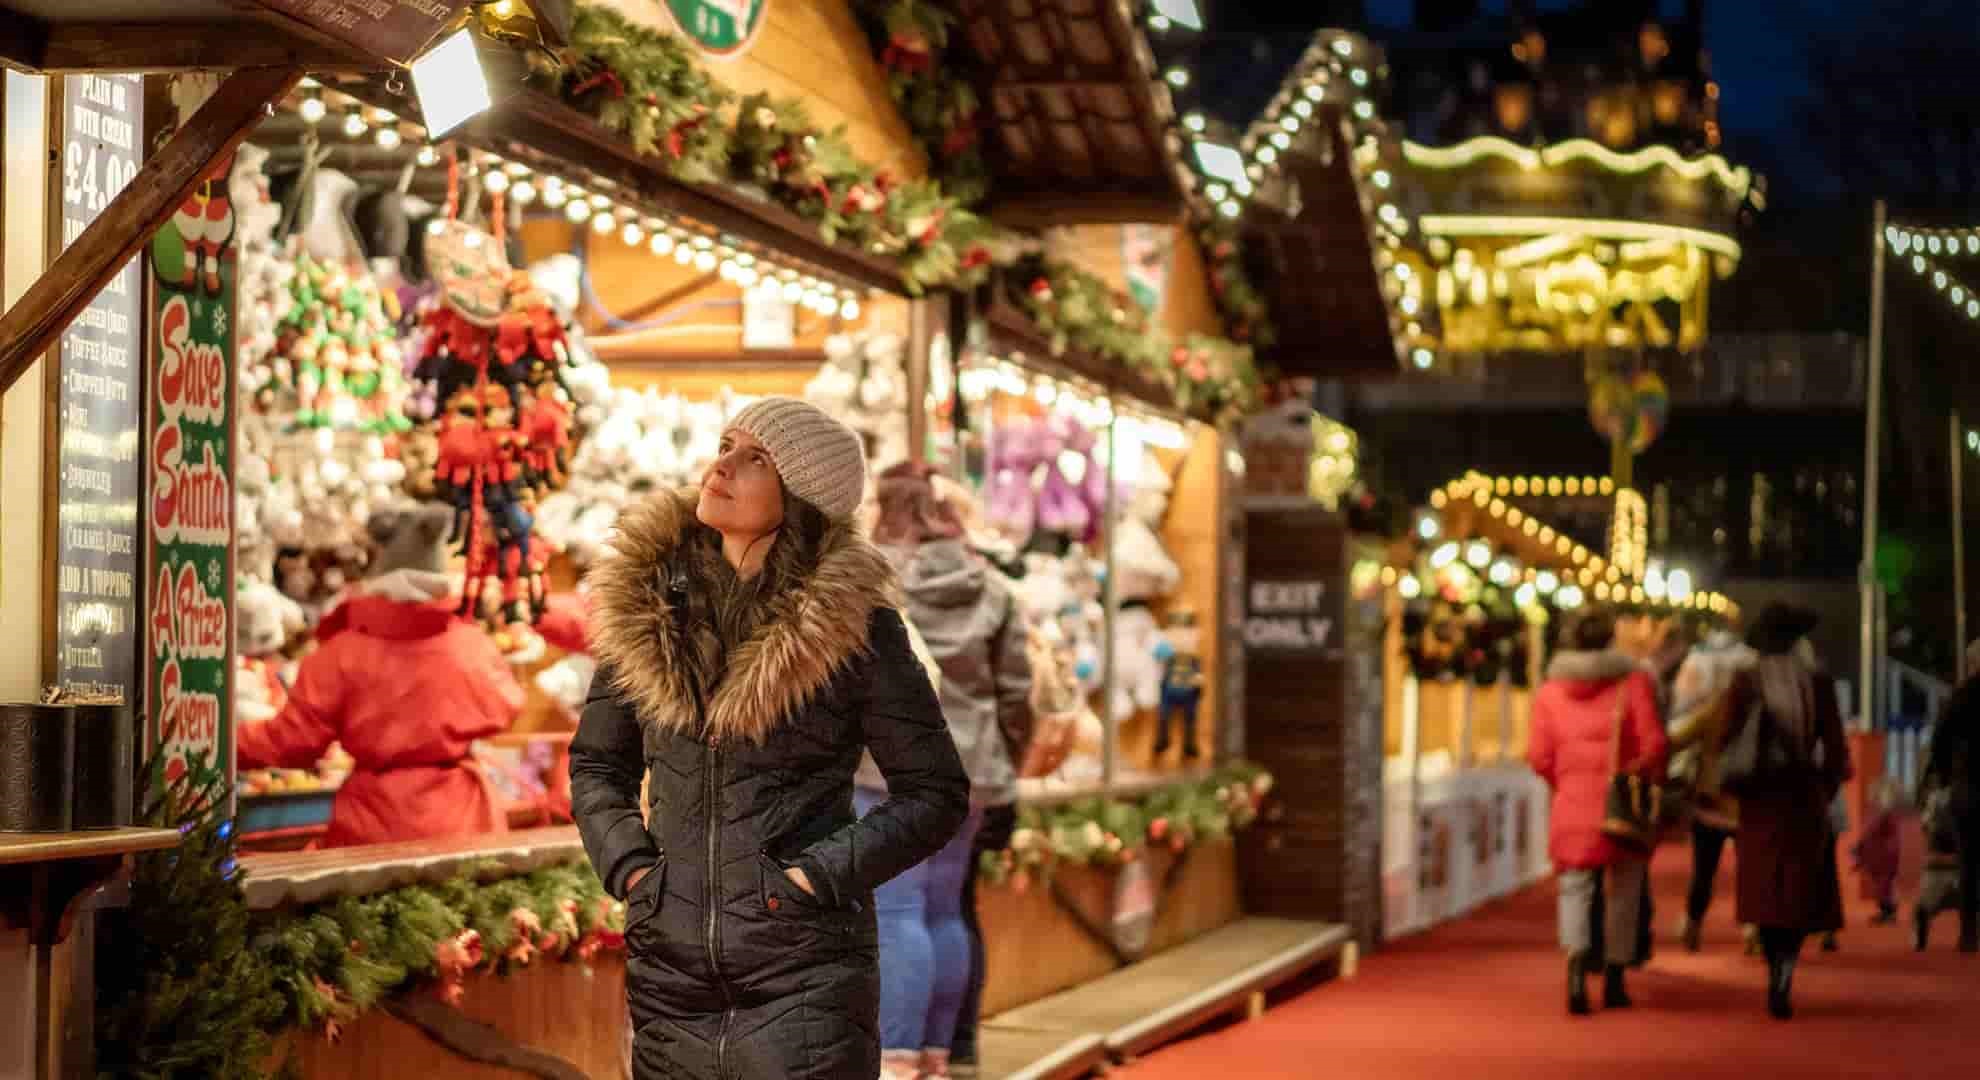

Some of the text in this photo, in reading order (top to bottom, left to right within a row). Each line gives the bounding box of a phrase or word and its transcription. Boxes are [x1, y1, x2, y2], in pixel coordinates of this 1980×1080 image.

[159, 297, 226, 424] Save
[154, 422, 229, 541] Santa
[59, 564, 80, 593] ADD
[90, 570, 131, 598] TOPPING
[152, 561, 225, 658] A Prize
[1251, 580, 1324, 610] EXIT
[1244, 616, 1333, 648] ONLY
[160, 659, 218, 766] Every
